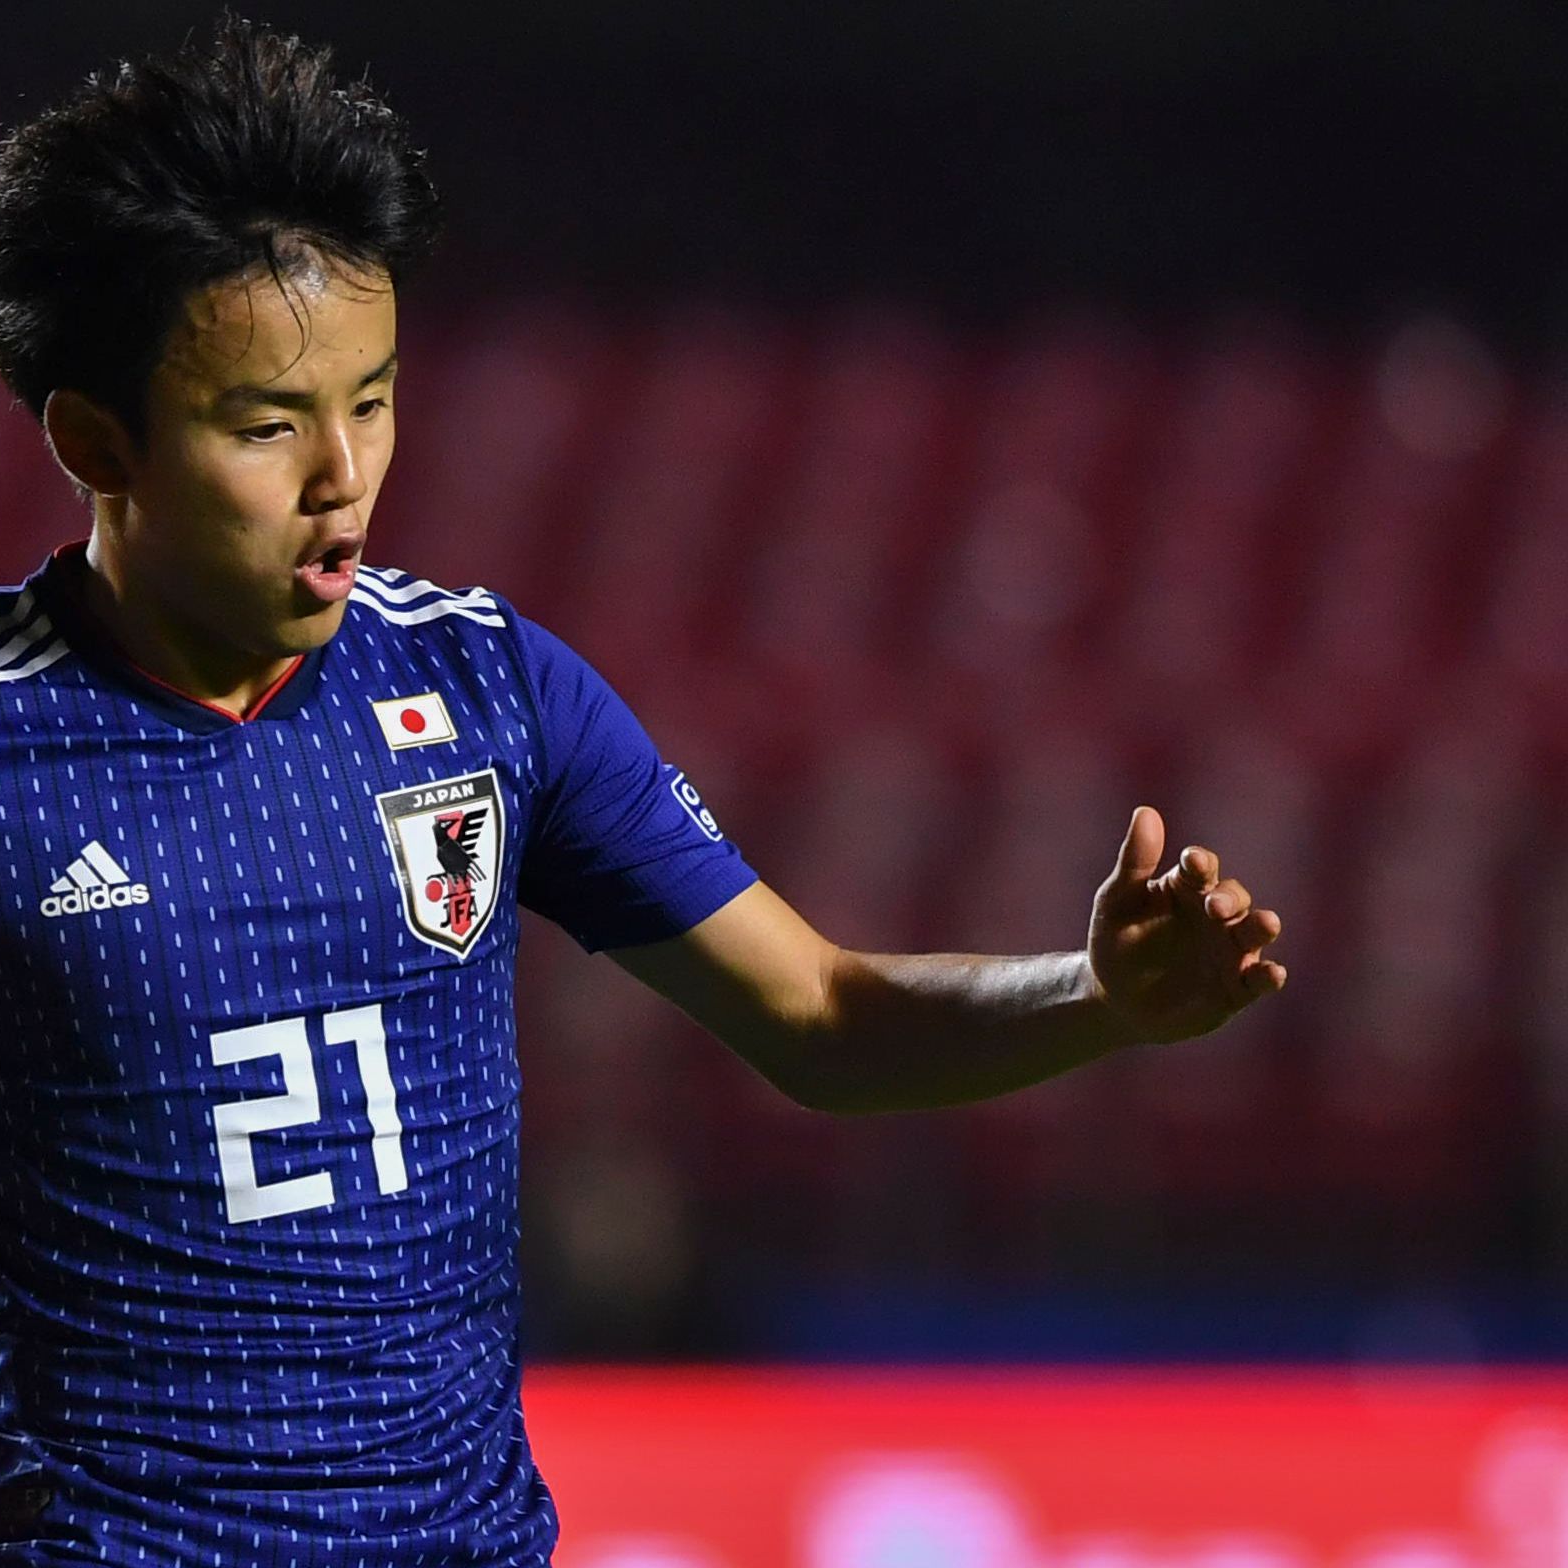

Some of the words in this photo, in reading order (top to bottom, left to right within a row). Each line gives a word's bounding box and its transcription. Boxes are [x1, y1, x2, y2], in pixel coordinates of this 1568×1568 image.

[413, 783, 475, 808] JAPAN
[40, 884, 150, 917] adidas
[440, 896, 478, 928] JFA
[210, 1003, 408, 1223] 21
